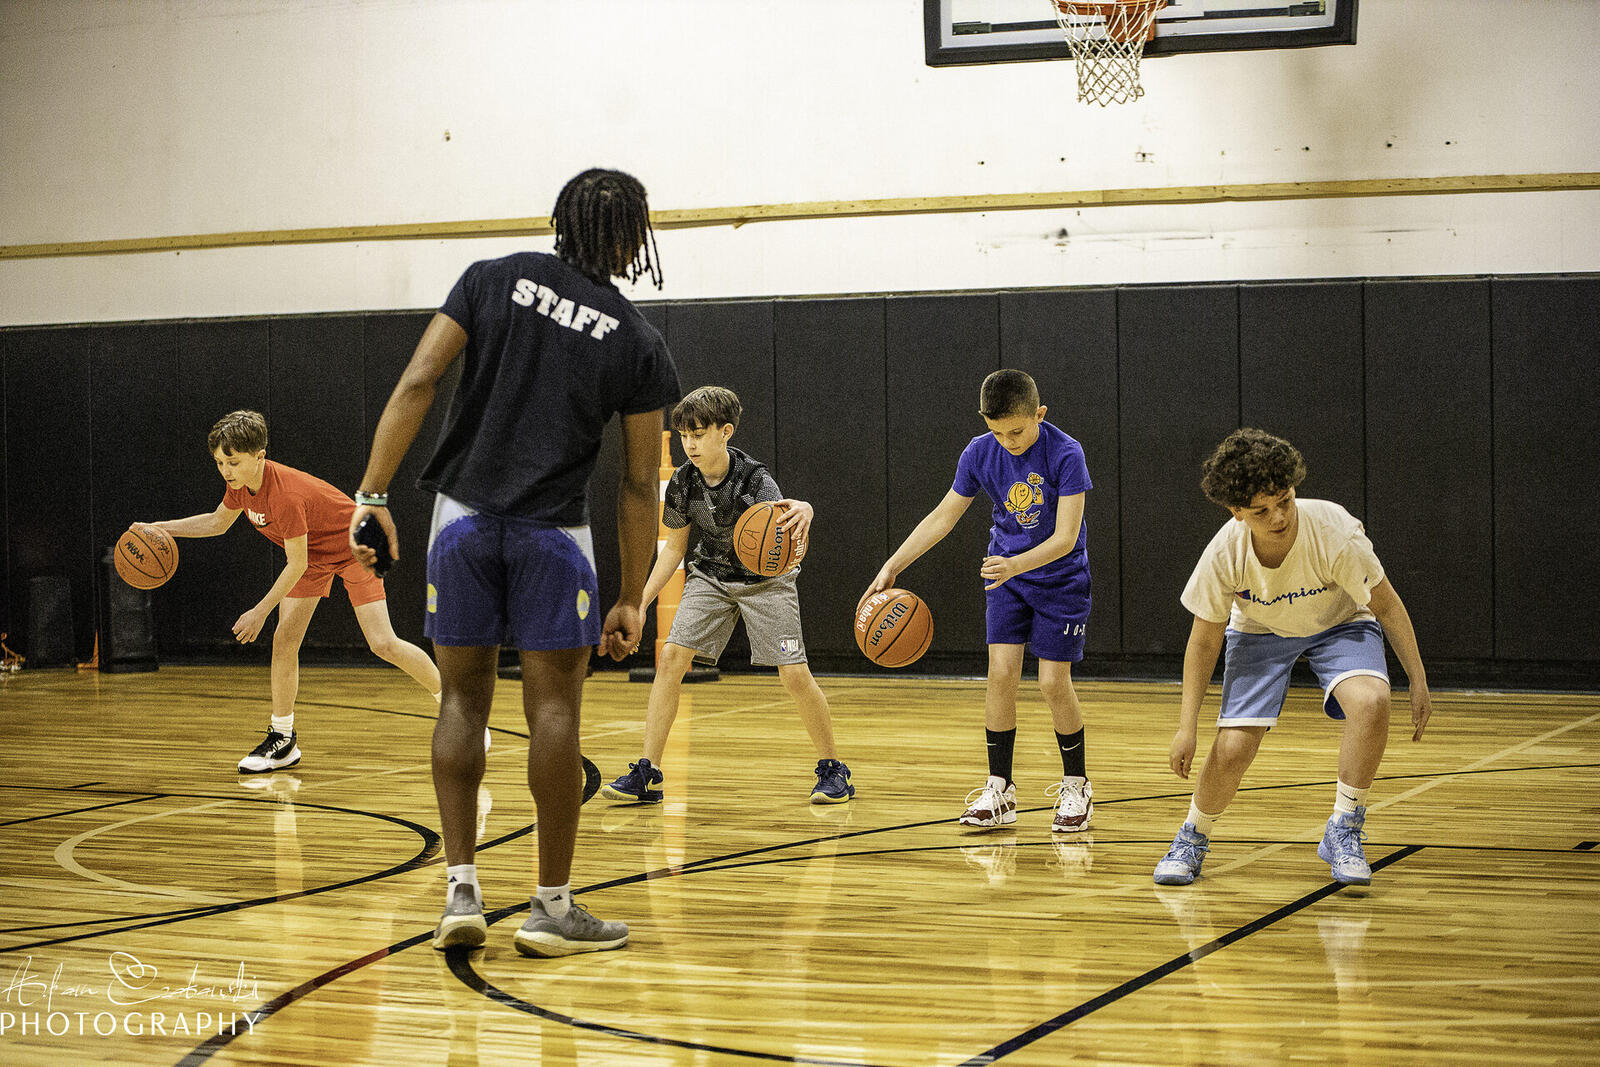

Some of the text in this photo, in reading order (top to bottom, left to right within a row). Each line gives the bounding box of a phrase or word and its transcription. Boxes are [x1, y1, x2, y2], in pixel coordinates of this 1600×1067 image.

[511, 278, 620, 341] STAFF
[765, 526, 785, 572] Wilson
[870, 602, 910, 647] Wilson
